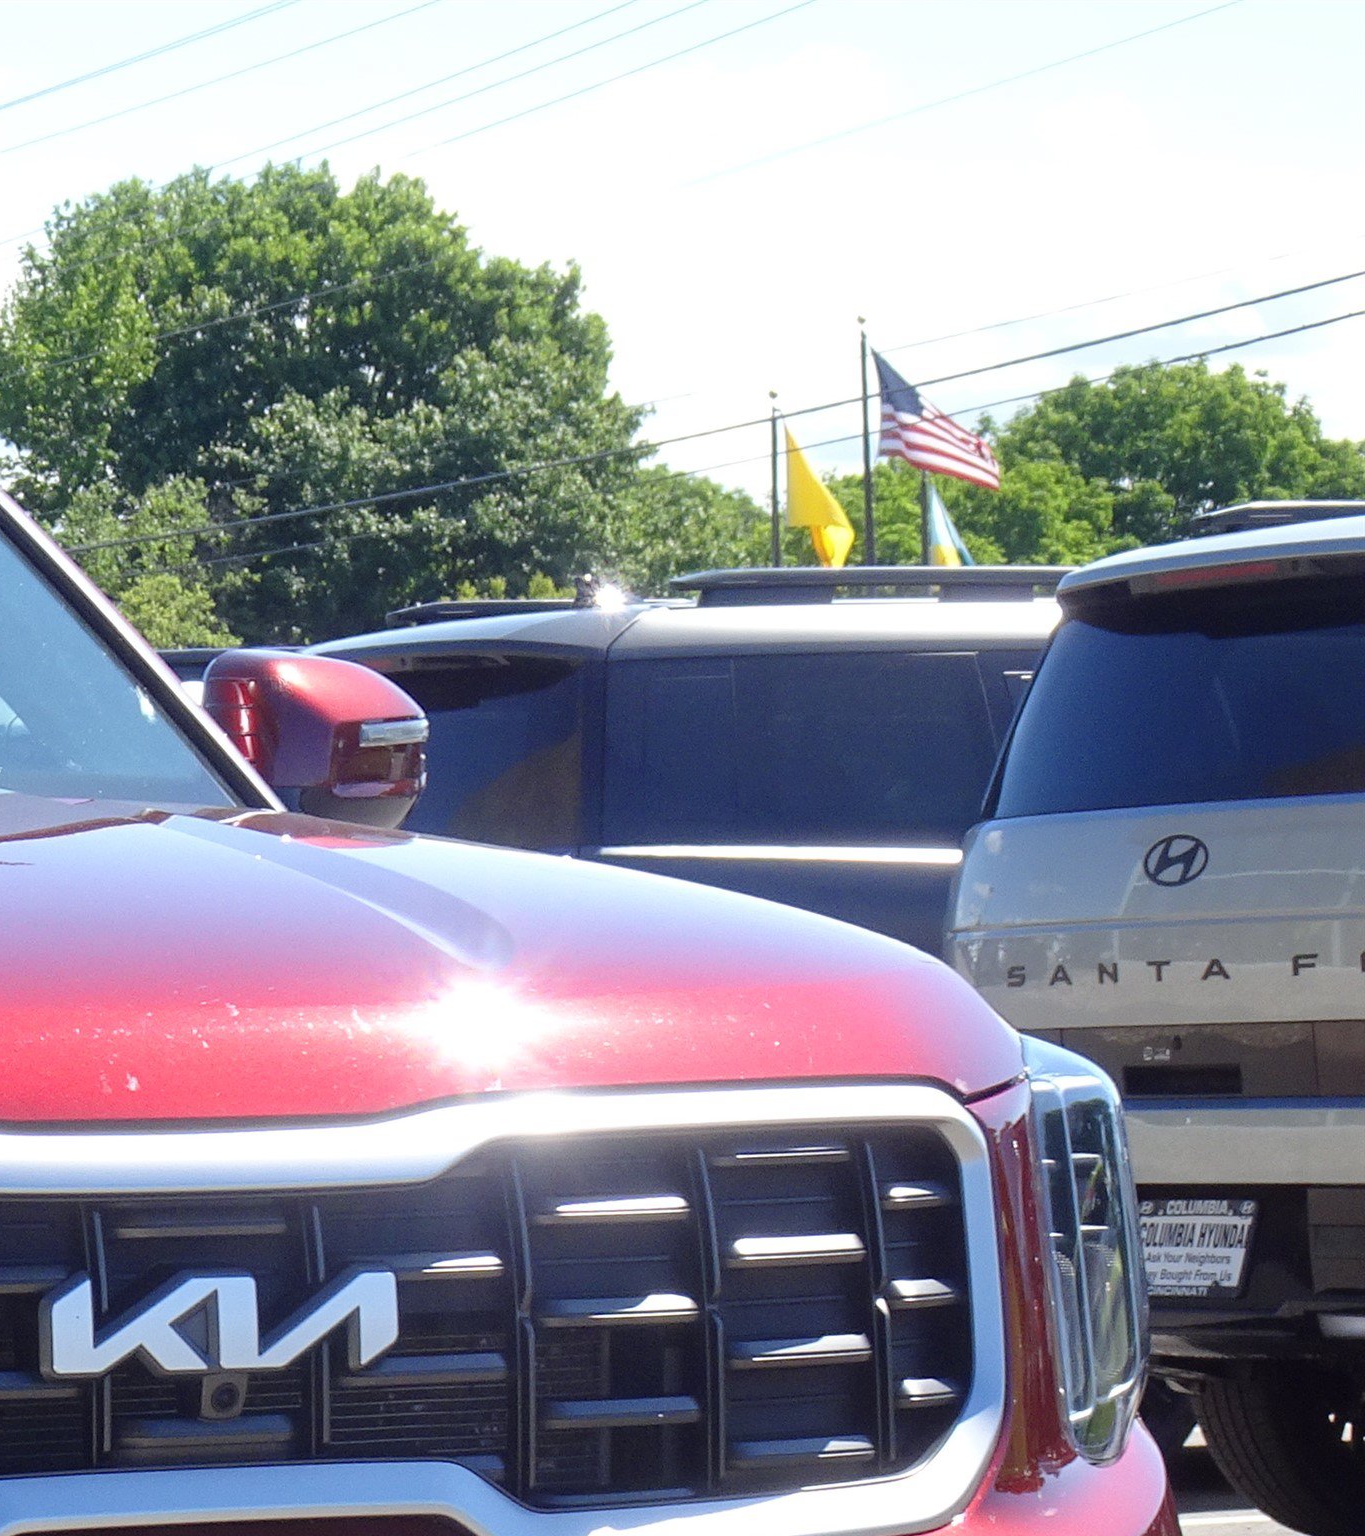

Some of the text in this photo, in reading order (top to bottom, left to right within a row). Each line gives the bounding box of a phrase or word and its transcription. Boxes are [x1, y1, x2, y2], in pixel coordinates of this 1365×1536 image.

[1007, 951, 1365, 988] SANTA F
[1146, 1252, 1231, 1267] Ask Your Neighbors
[1160, 1269, 1193, 1283] Bought
[1194, 1270, 1217, 1281] From
[1220, 1270, 1233, 1282] Us
[47, 1272, 399, 1376] KIA
